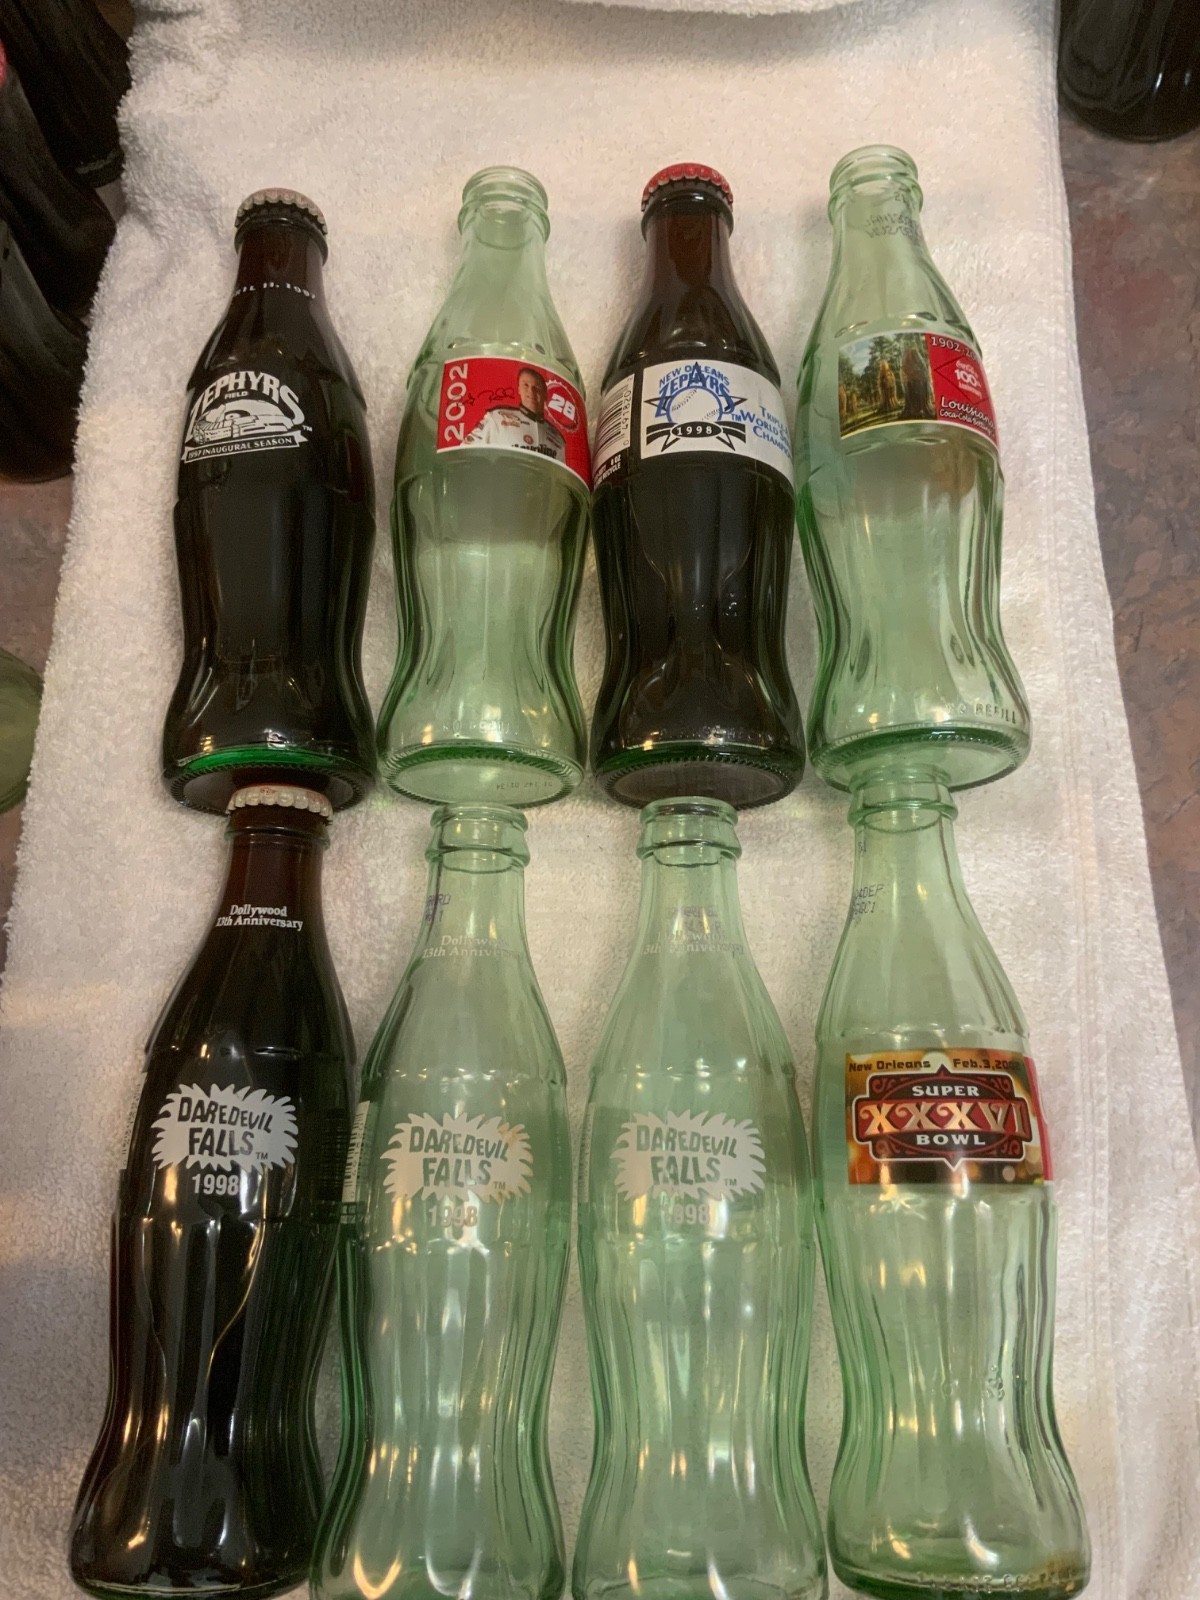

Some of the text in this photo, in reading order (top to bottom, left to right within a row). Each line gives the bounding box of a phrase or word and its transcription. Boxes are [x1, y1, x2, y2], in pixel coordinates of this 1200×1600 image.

[658, 367, 681, 388] NEW
[184, 370, 305, 444] ZEPHYRS
[224, 390, 248, 400] FIELD
[443, 362, 469, 443] 2002
[548, 393, 576, 421] 28
[676, 425, 713, 437] 1998
[202, 440, 251, 456] INAUGURAL
[254, 436, 293, 448] SEASON
[229, 903, 288, 918] Dollywood
[233, 914, 304, 932] Anniversary
[848, 1062, 873, 1073] New
[876, 1059, 932, 1071] Orleans
[912, 1085, 980, 1097] SUPER
[177, 1096, 273, 1134] DAREDEVIL
[859, 1102, 1027, 1137] XXXVI
[188, 1127, 255, 1157] FALLS
[408, 1125, 509, 1162] DAREDEVIL
[636, 1124, 738, 1159] DAREDEVIL
[916, 1134, 986, 1146] BOWL
[422, 1157, 492, 1187] FALLS
[651, 1155, 721, 1186] FALLS
[192, 1173, 239, 1196] 1998
